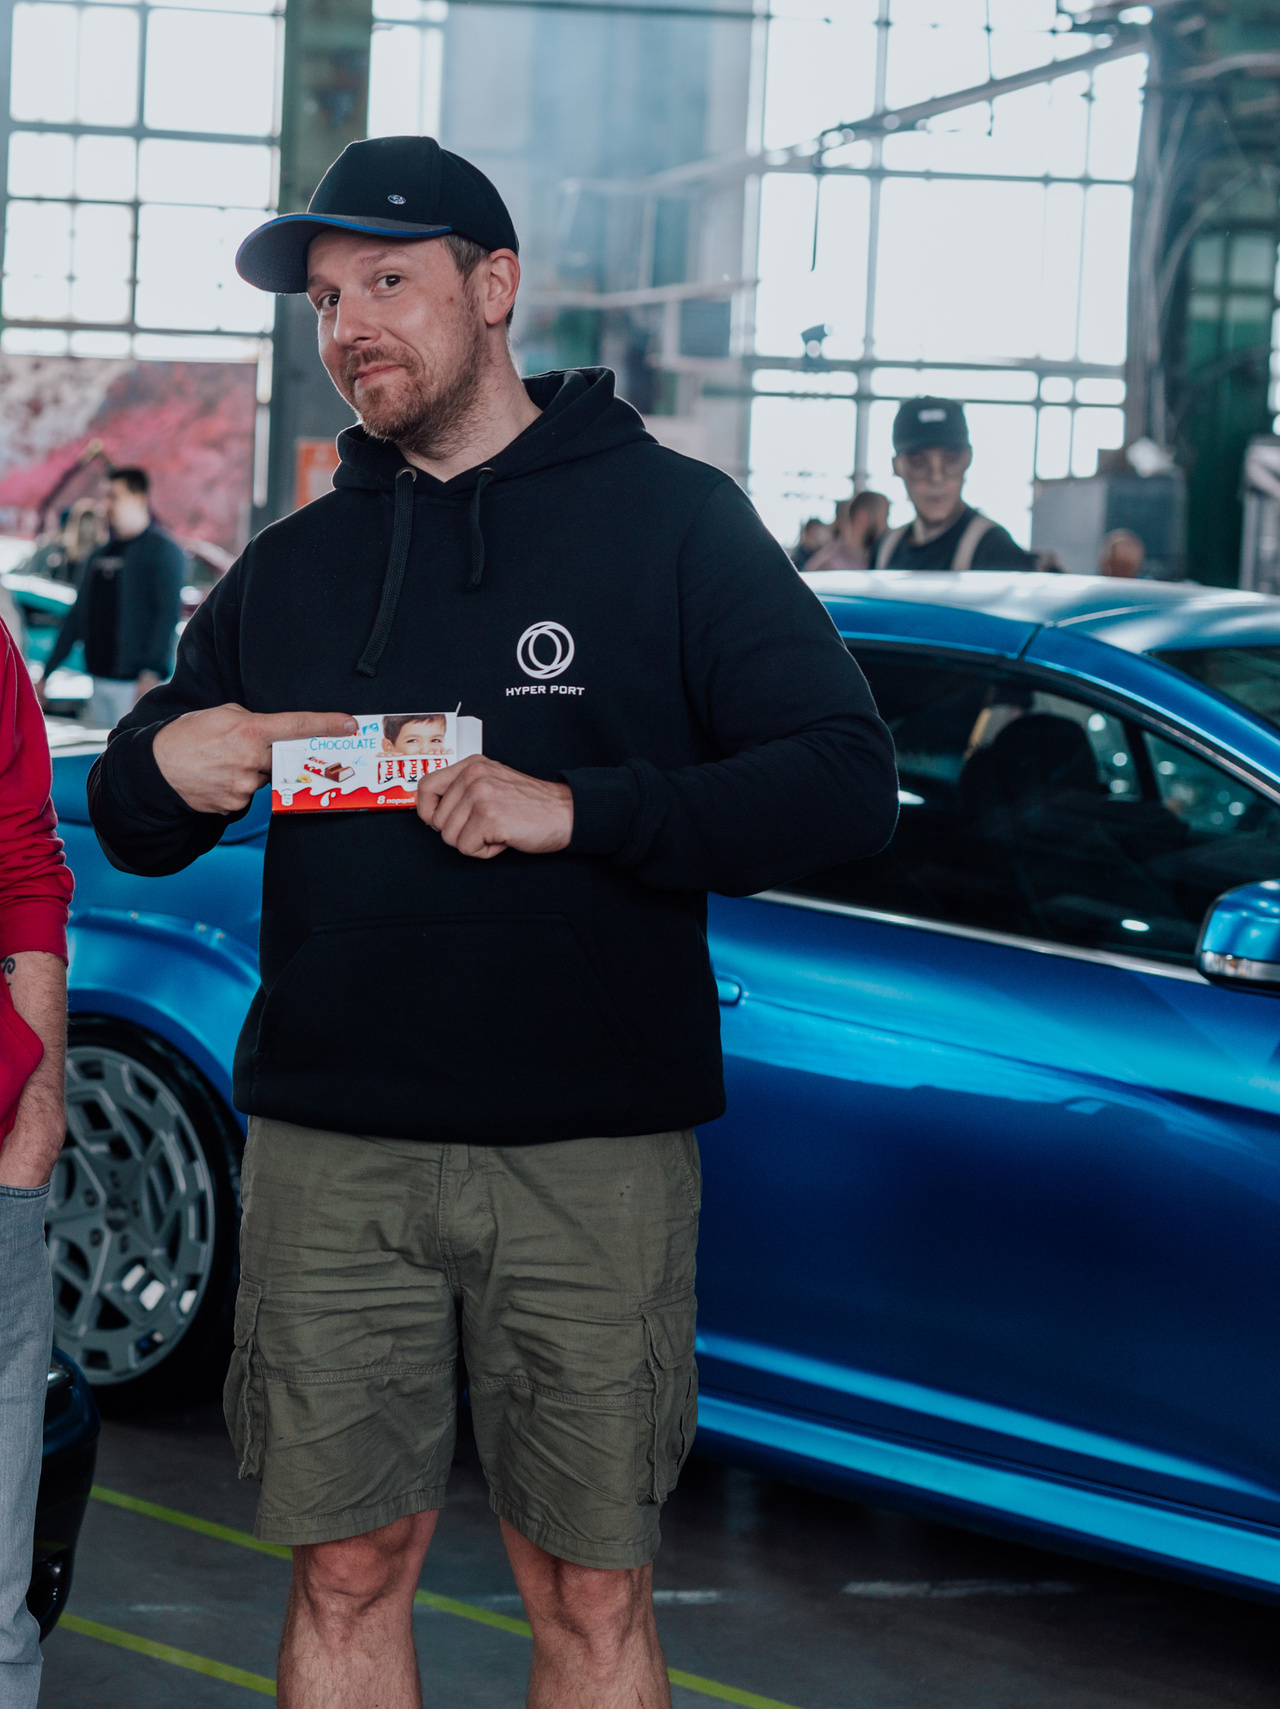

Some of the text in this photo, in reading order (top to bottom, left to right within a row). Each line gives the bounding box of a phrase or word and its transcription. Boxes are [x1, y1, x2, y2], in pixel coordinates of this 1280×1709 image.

[505, 685, 585, 697] HYPER PORT
[309, 737, 377, 751] CHOCOLATE
[377, 796, 386, 805] 8
